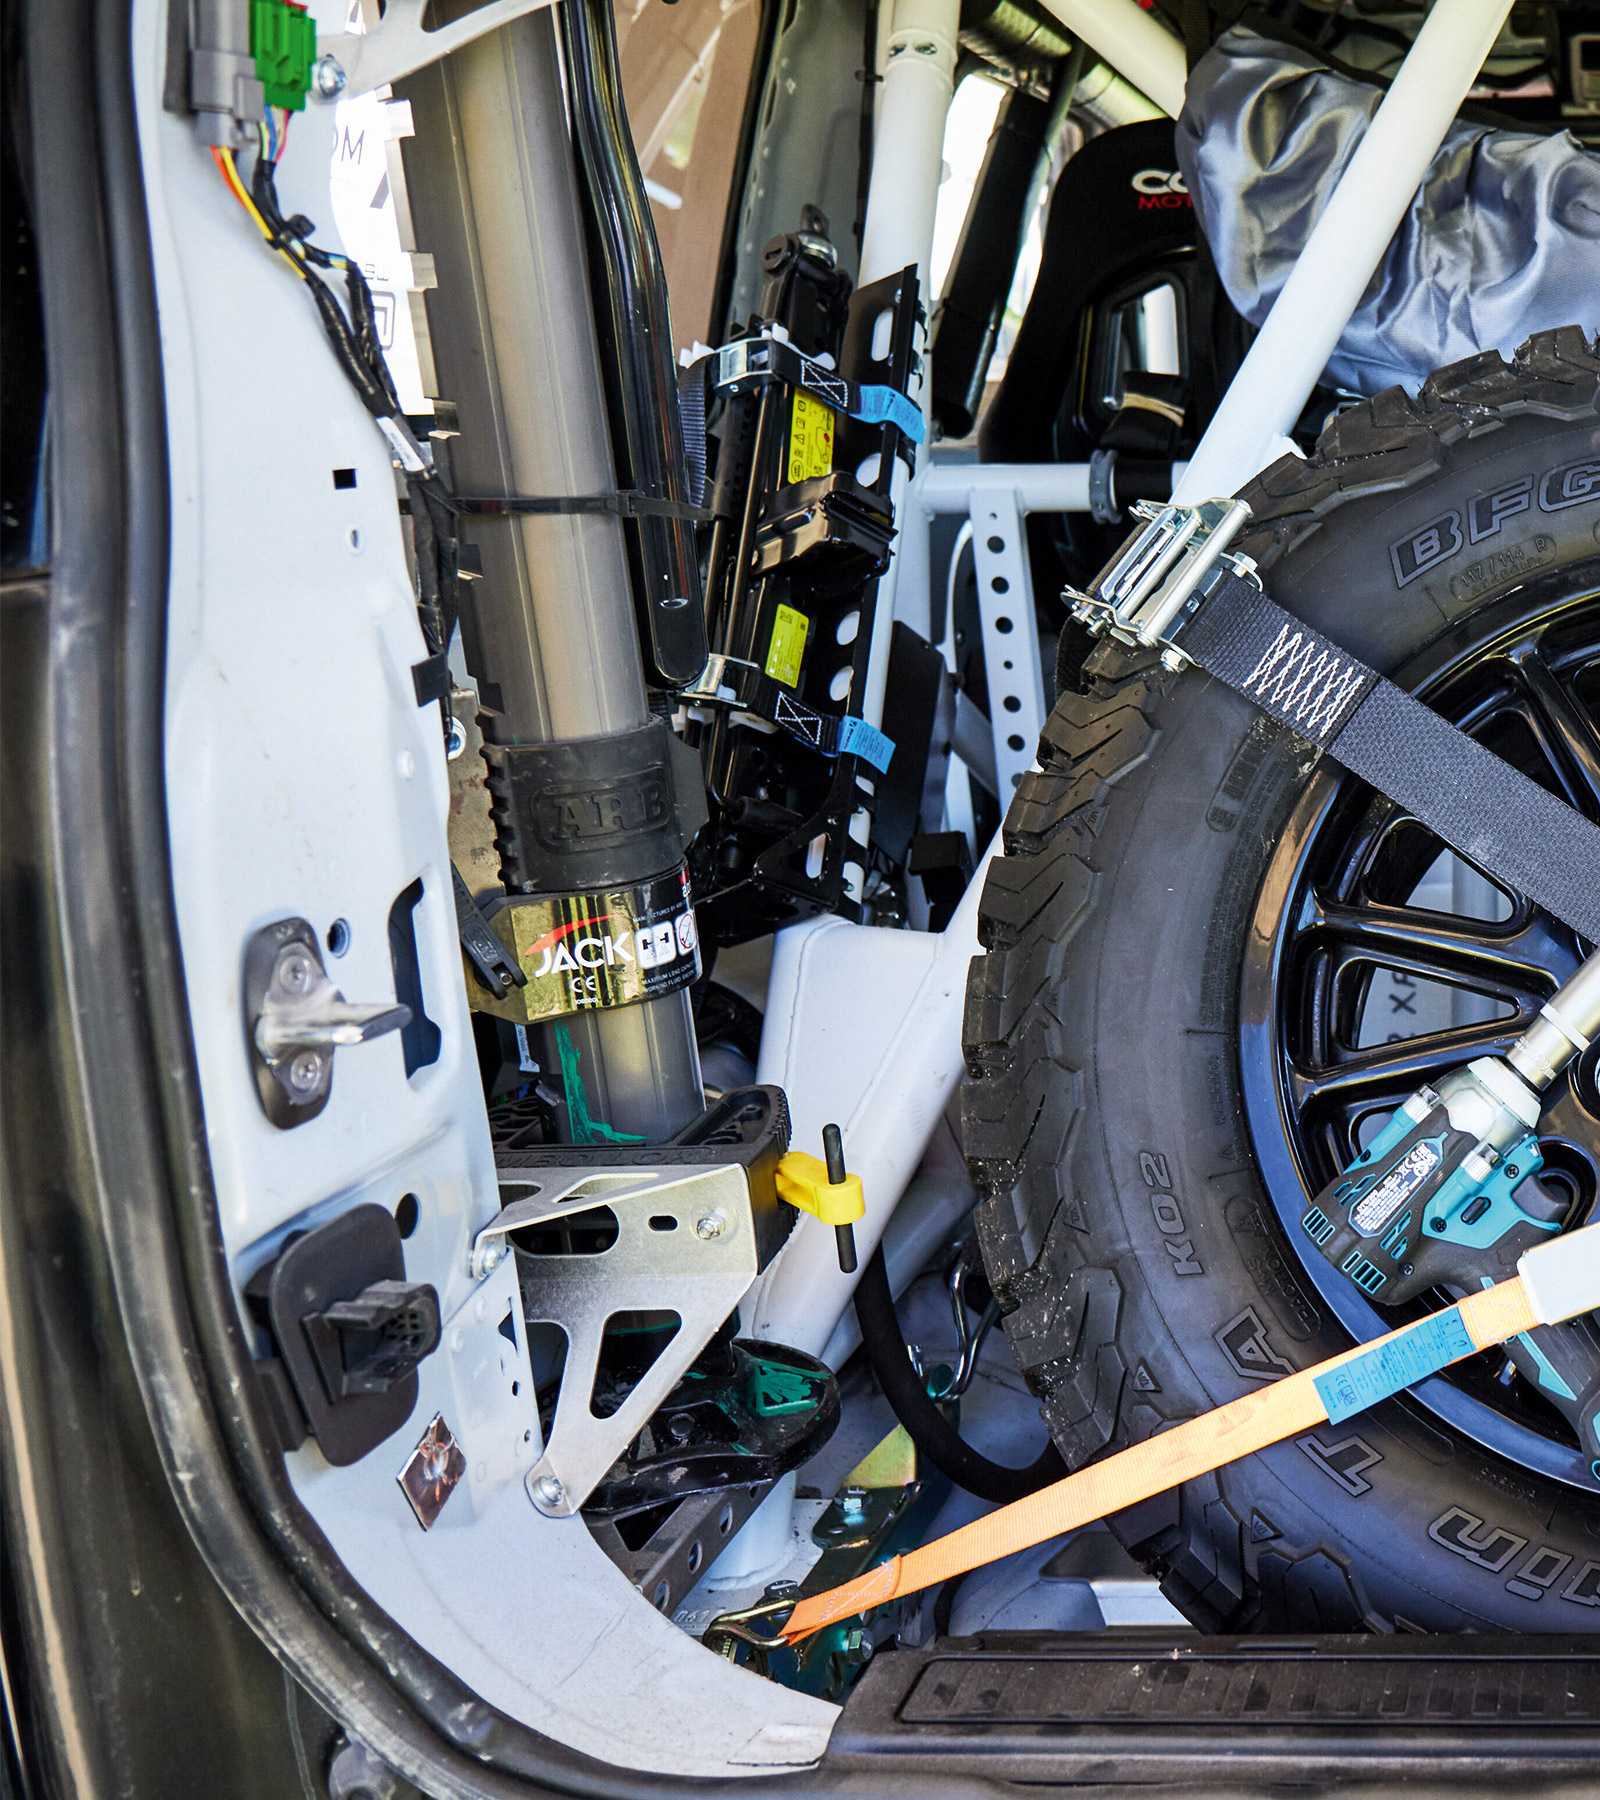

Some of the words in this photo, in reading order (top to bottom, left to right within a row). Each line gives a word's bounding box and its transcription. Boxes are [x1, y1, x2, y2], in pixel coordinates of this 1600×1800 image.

[1460, 564, 1484, 587] 117
[1535, 537, 1549, 555] R
[553, 787, 664, 840] ARB
[534, 931, 636, 978] JACK
